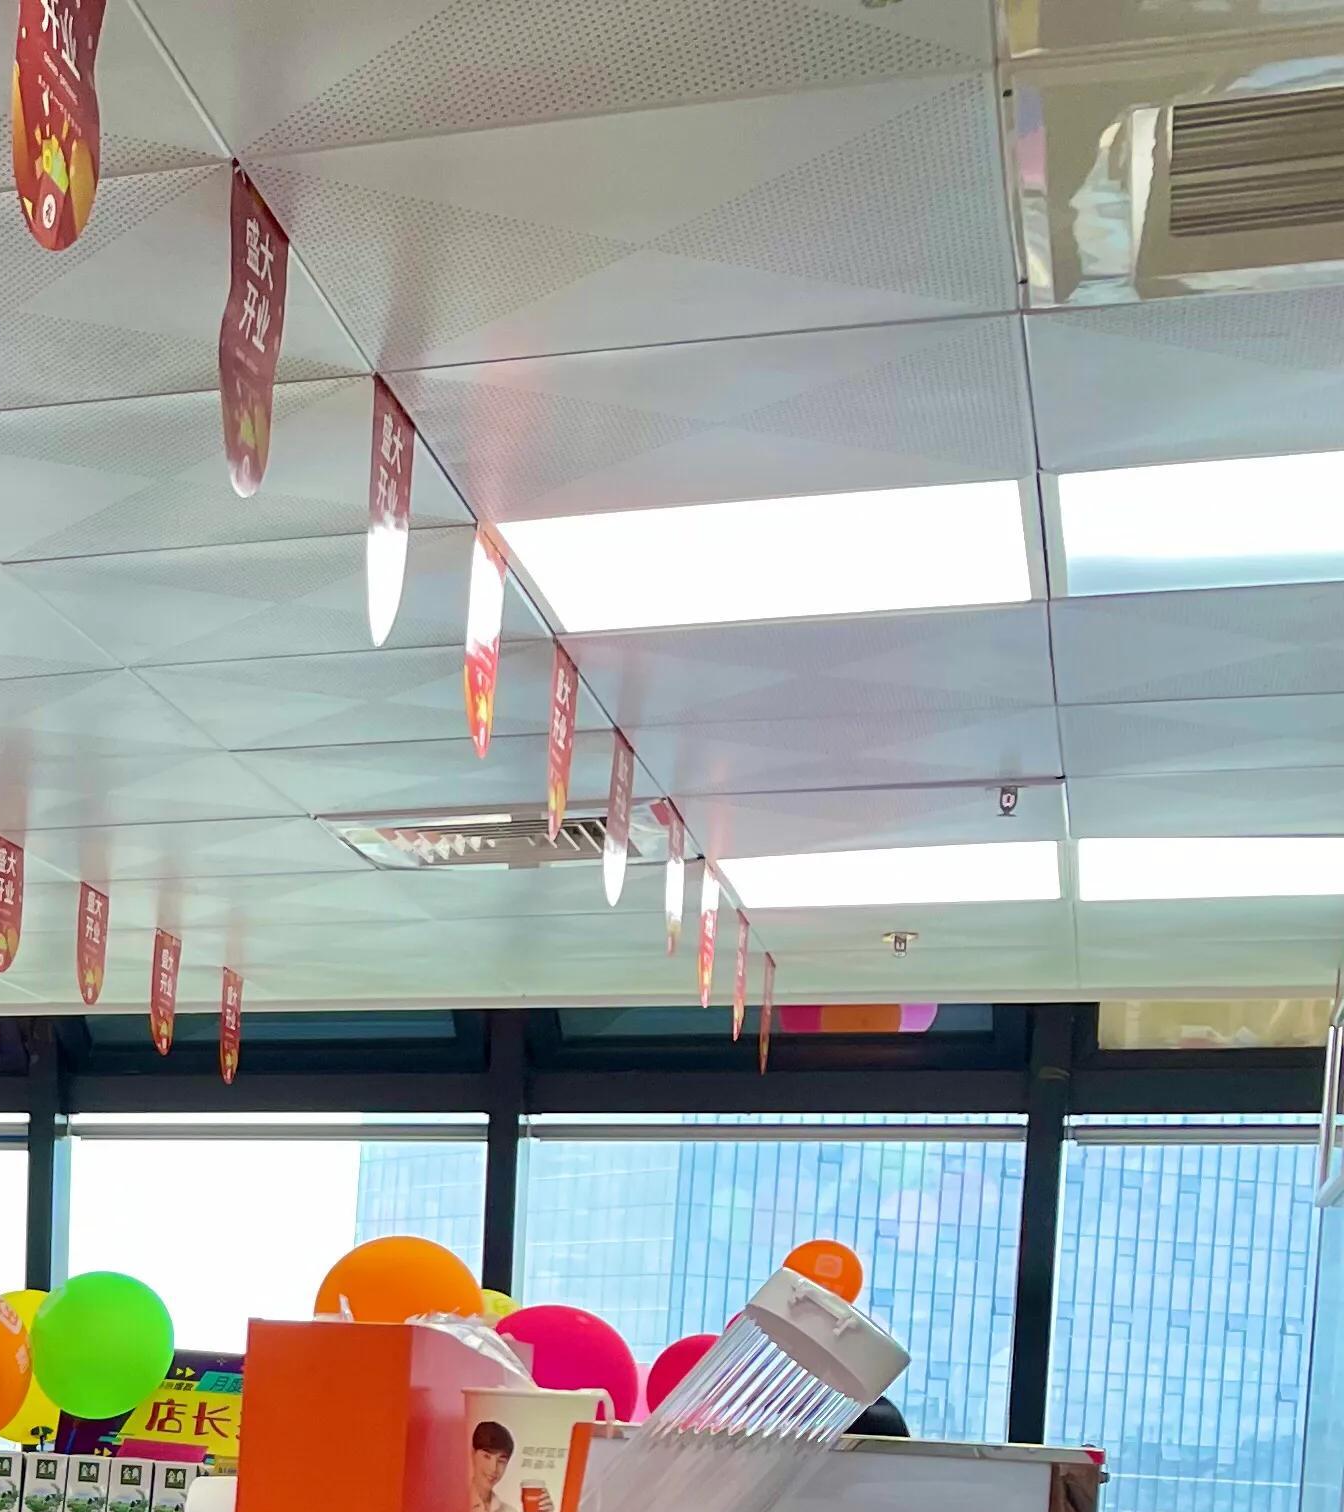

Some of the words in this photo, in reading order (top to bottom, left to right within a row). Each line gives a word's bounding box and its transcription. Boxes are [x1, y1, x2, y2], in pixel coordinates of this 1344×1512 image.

[245, 216, 275, 292] 盛大
[238, 289, 268, 353] 开业
[381, 413, 405, 475] 盛大
[145, 1398, 241, 1439] 店长
